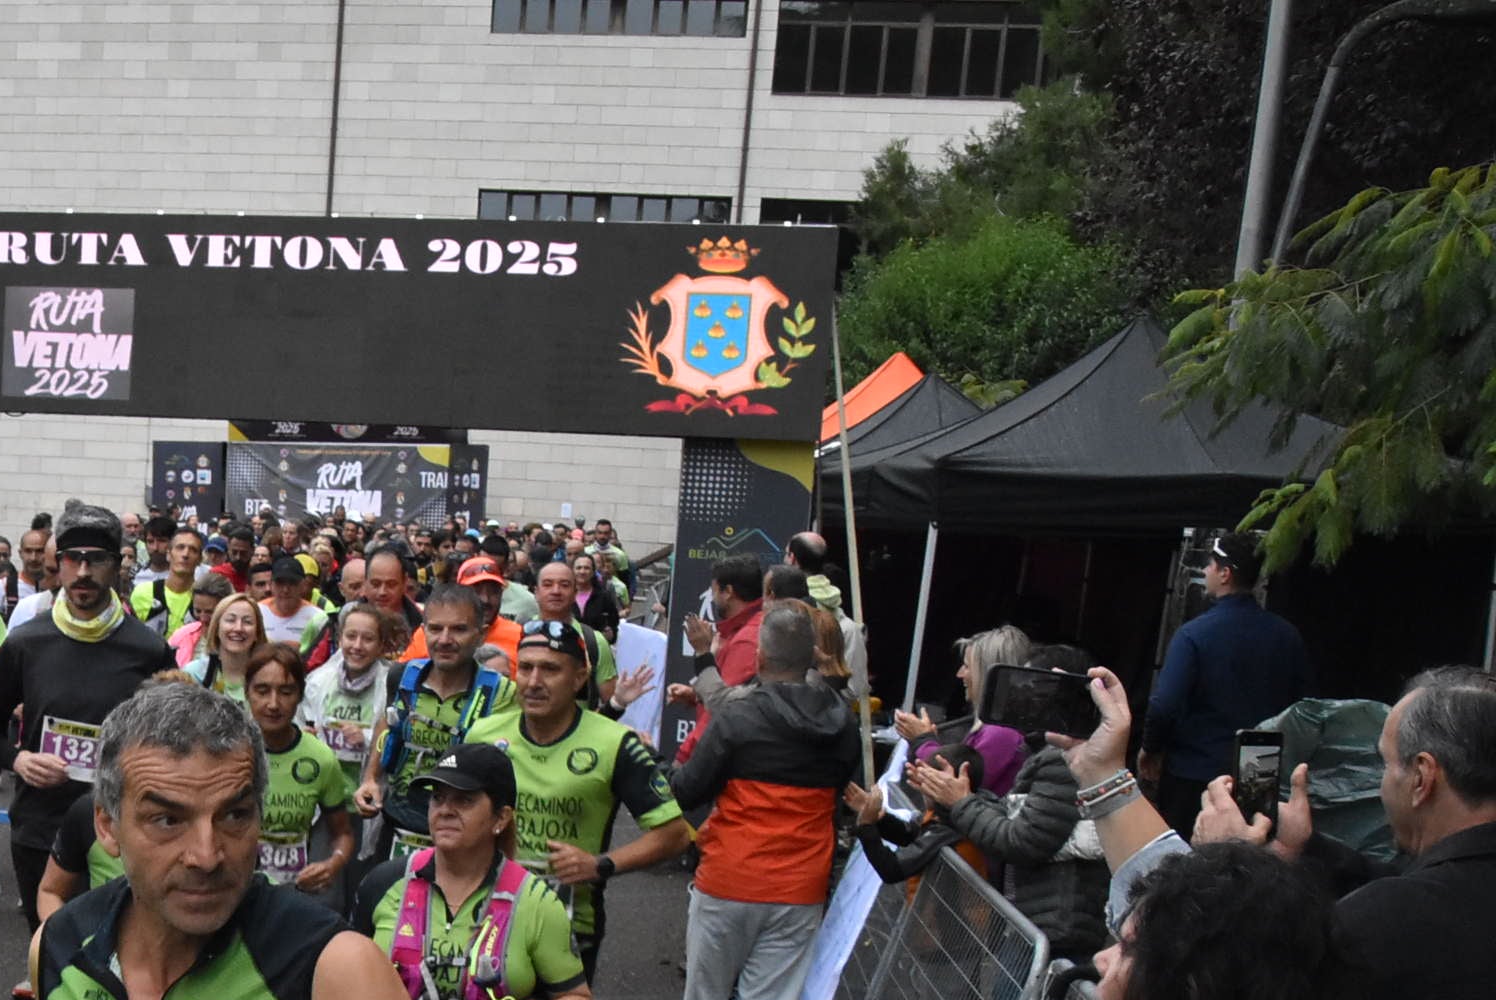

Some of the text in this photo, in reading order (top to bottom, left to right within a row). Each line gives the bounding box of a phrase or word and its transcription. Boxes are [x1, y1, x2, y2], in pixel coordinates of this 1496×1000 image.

[164, 233, 408, 273] VETONA
[427, 239, 579, 276] 2025
[29, 289, 106, 333] RUTA
[11, 332, 133, 371] VETONA
[24, 368, 109, 399] 2025
[316, 460, 364, 491] RUTA
[52, 735, 97, 763] 132
